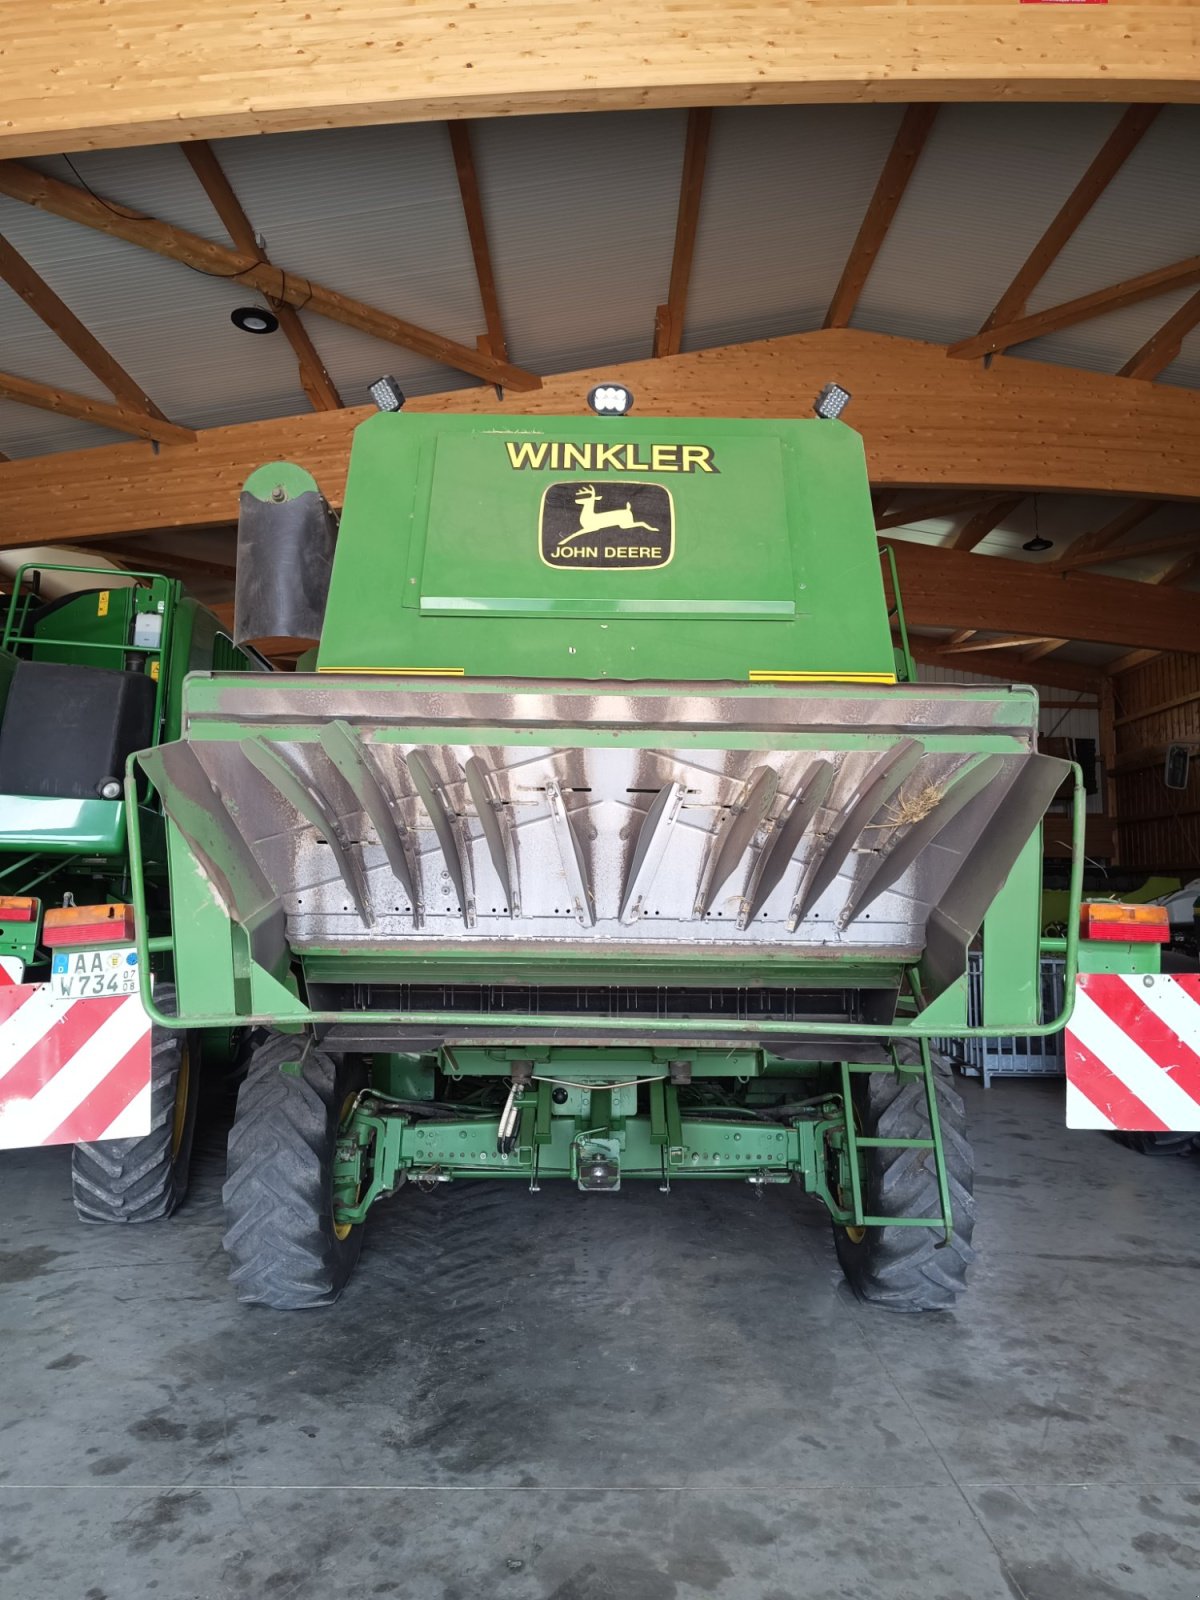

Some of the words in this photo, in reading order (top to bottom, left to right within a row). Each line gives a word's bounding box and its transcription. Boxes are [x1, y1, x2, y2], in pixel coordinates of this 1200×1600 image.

[506, 442, 718, 472] WINKLER
[551, 546, 598, 559] JOHN
[604, 546, 662, 559] DEERE
[75, 953, 103, 974] AA
[60, 976, 74, 996] W
[79, 973, 119, 996] 734
